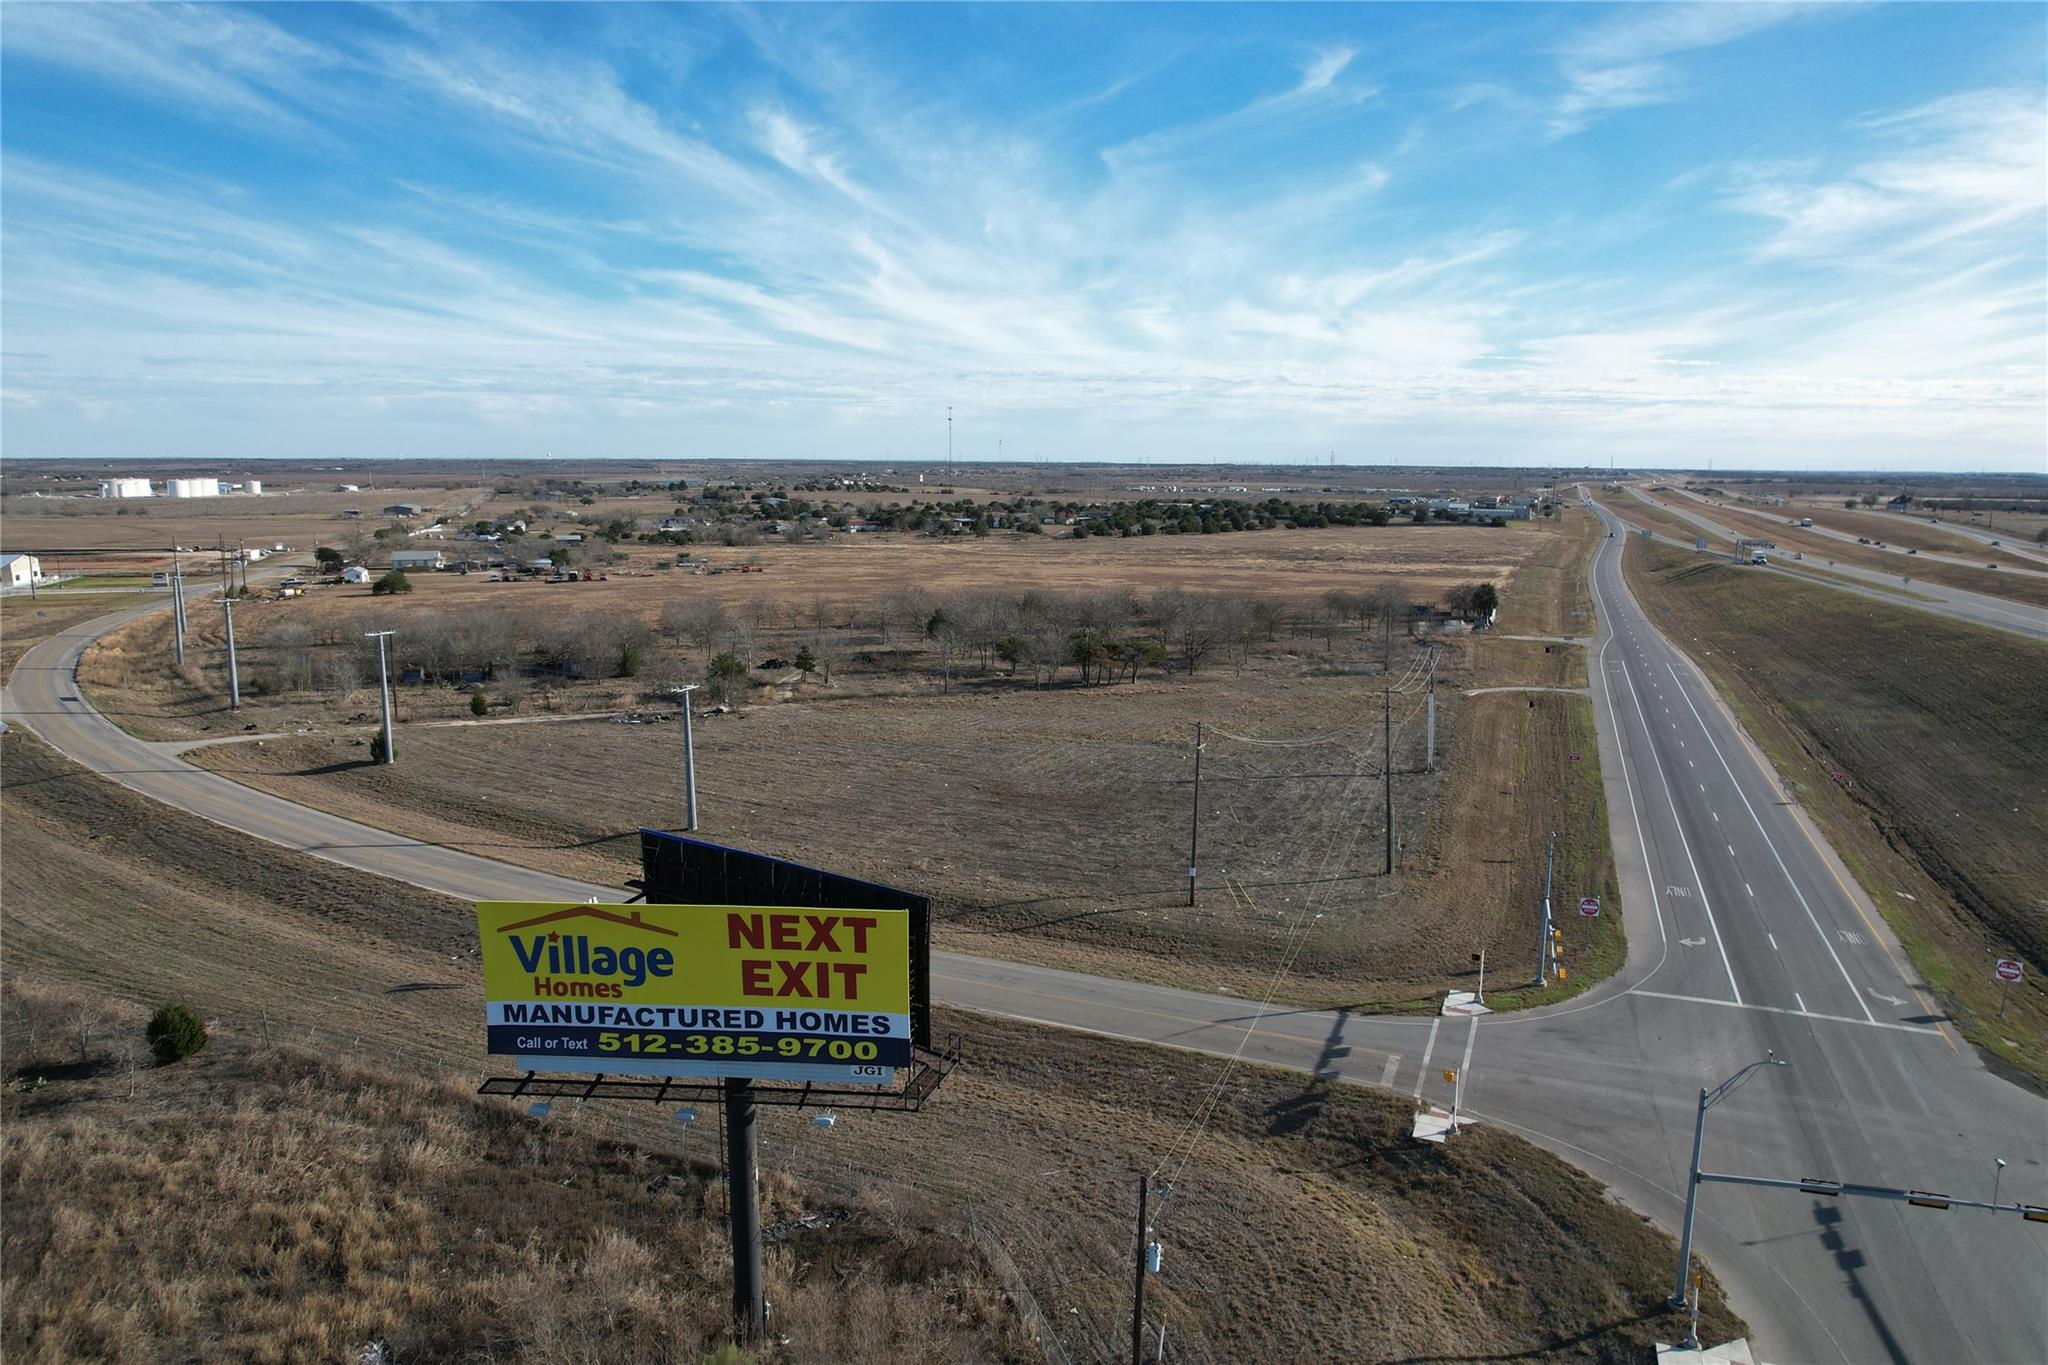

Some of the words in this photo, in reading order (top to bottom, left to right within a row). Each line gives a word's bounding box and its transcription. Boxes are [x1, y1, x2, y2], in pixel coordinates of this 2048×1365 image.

[1666, 885, 1691, 897] ONLY
[727, 913, 877, 953] NEXT
[509, 933, 674, 986] Village
[534, 976, 623, 998] Homes
[742, 960, 867, 1000] EXIT
[503, 1004, 764, 1029] MANUFACTURED
[776, 1011, 891, 1034] HOMES
[517, 1036, 541, 1050] Call
[544, 1039, 558, 1049] or
[561, 1037, 588, 1050] Text
[598, 1032, 878, 1060] 512-385-9700
[853, 1066, 883, 1076] JGI
